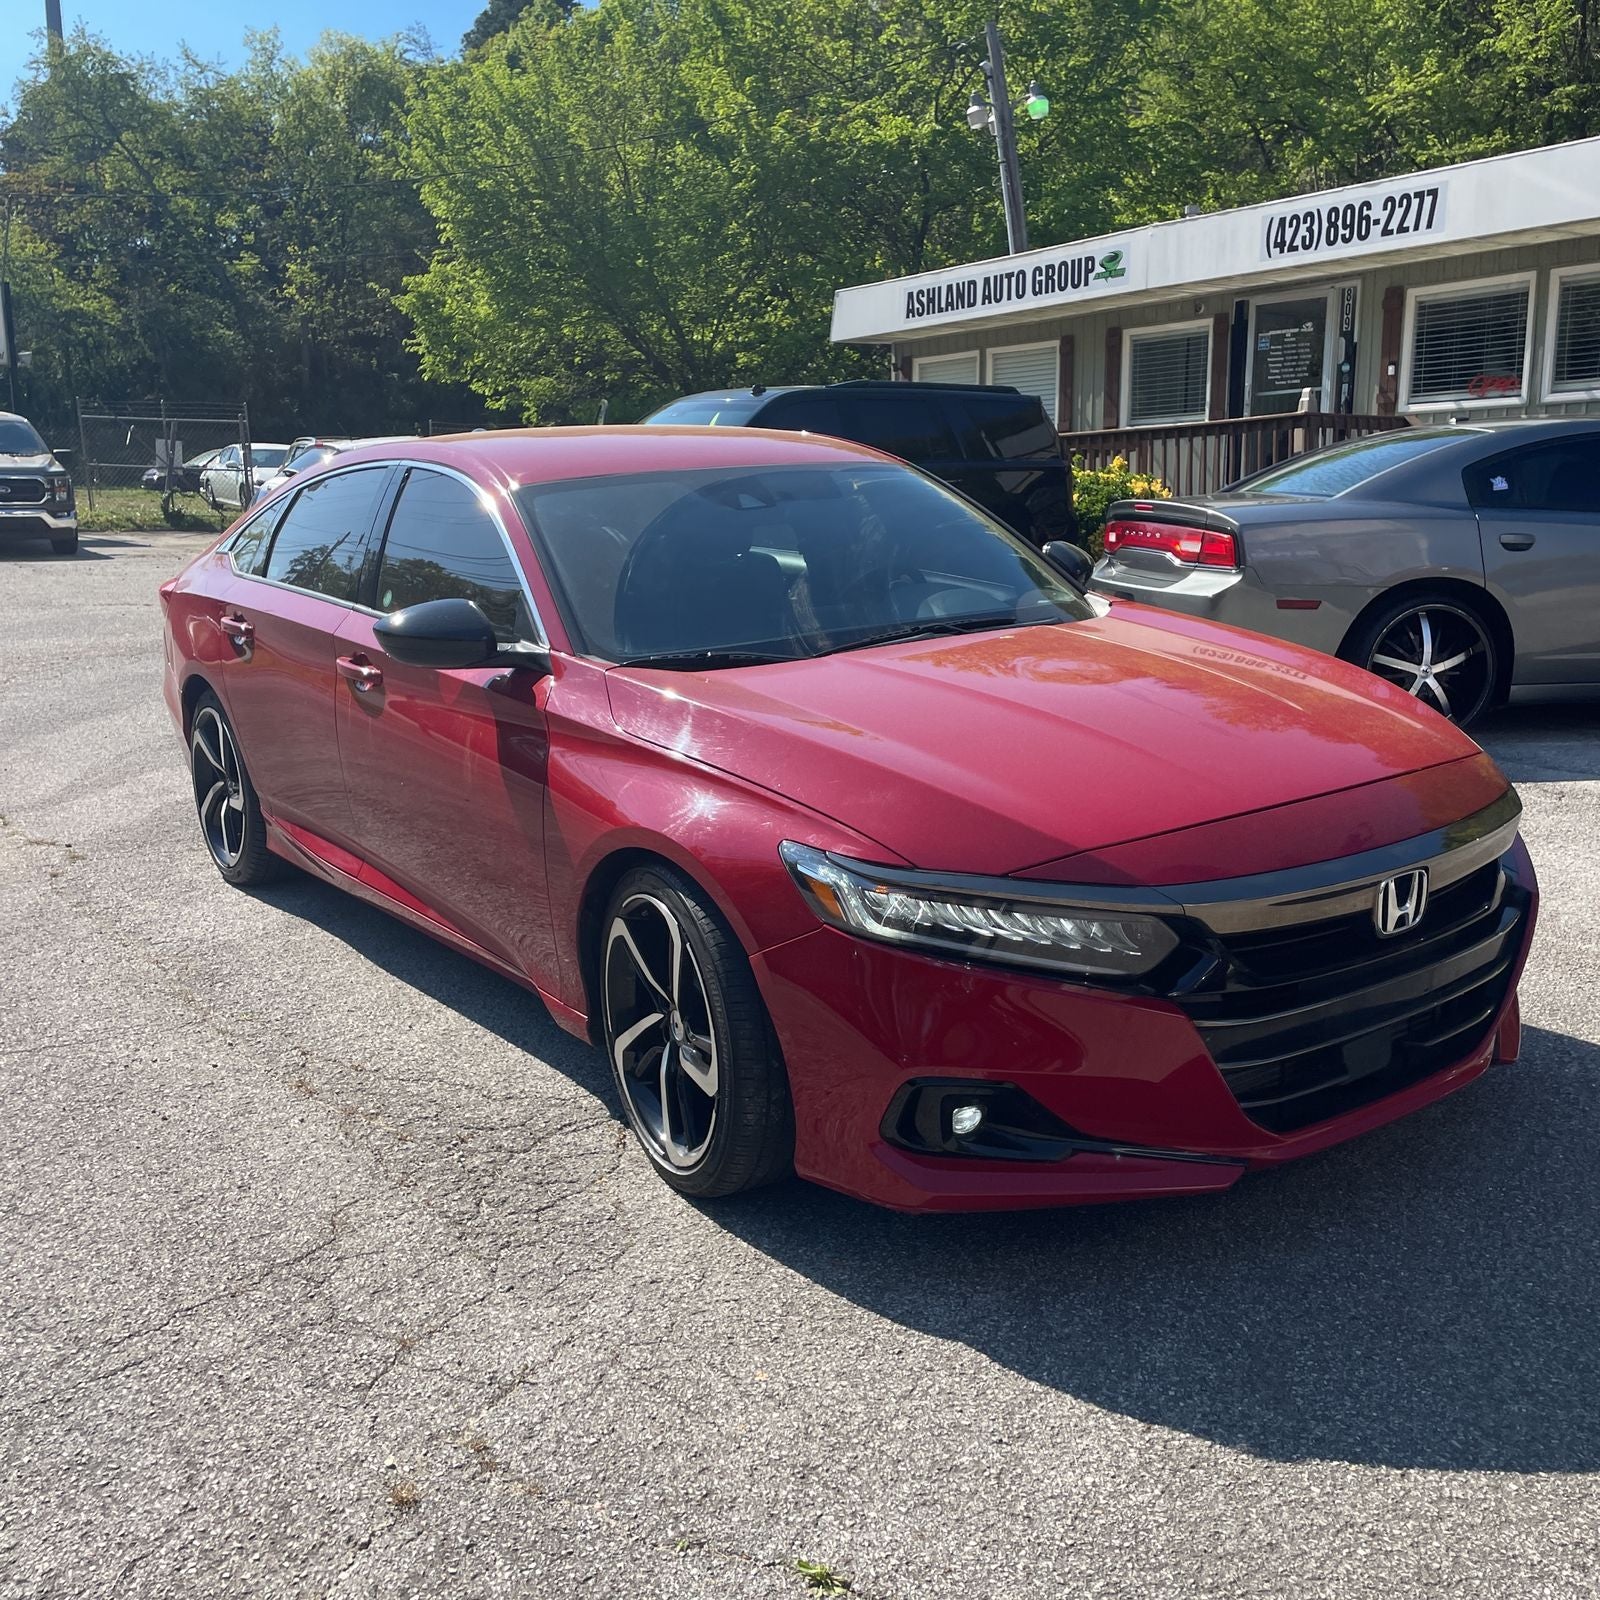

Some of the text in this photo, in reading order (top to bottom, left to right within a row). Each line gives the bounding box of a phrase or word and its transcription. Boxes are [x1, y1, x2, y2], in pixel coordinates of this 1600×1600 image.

[1266, 187, 1439, 258] (423)896-2277
[906, 255, 1096, 319] ASHLAND AUTO GROUP
[1344, 288, 1352, 330] 809
